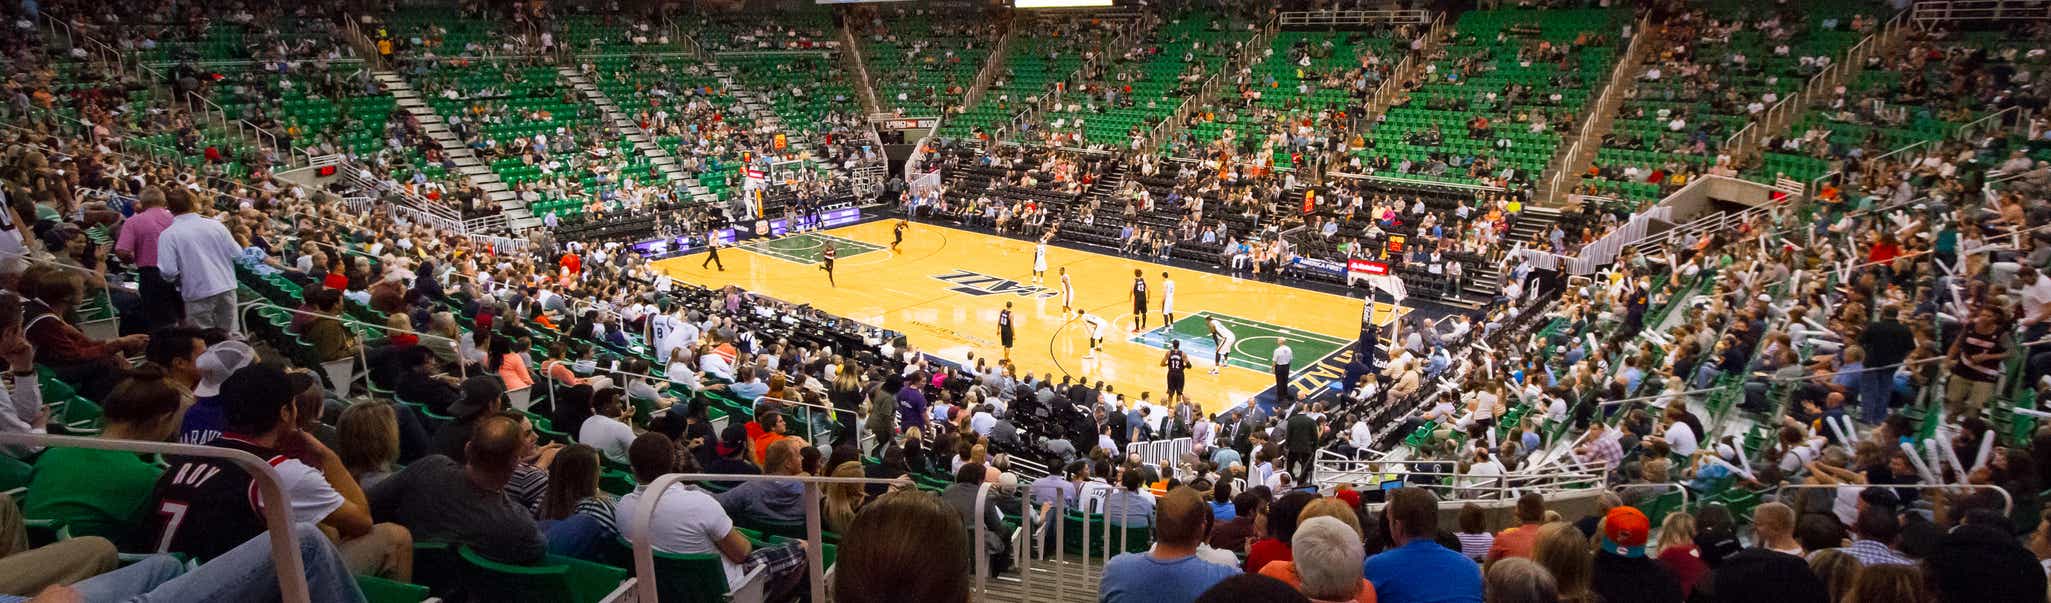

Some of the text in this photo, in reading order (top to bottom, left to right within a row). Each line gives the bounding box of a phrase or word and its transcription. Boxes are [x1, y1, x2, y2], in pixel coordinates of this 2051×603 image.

[1171, 360, 1180, 369] 12
[172, 462, 220, 488] ROY
[158, 500, 189, 554] 7
